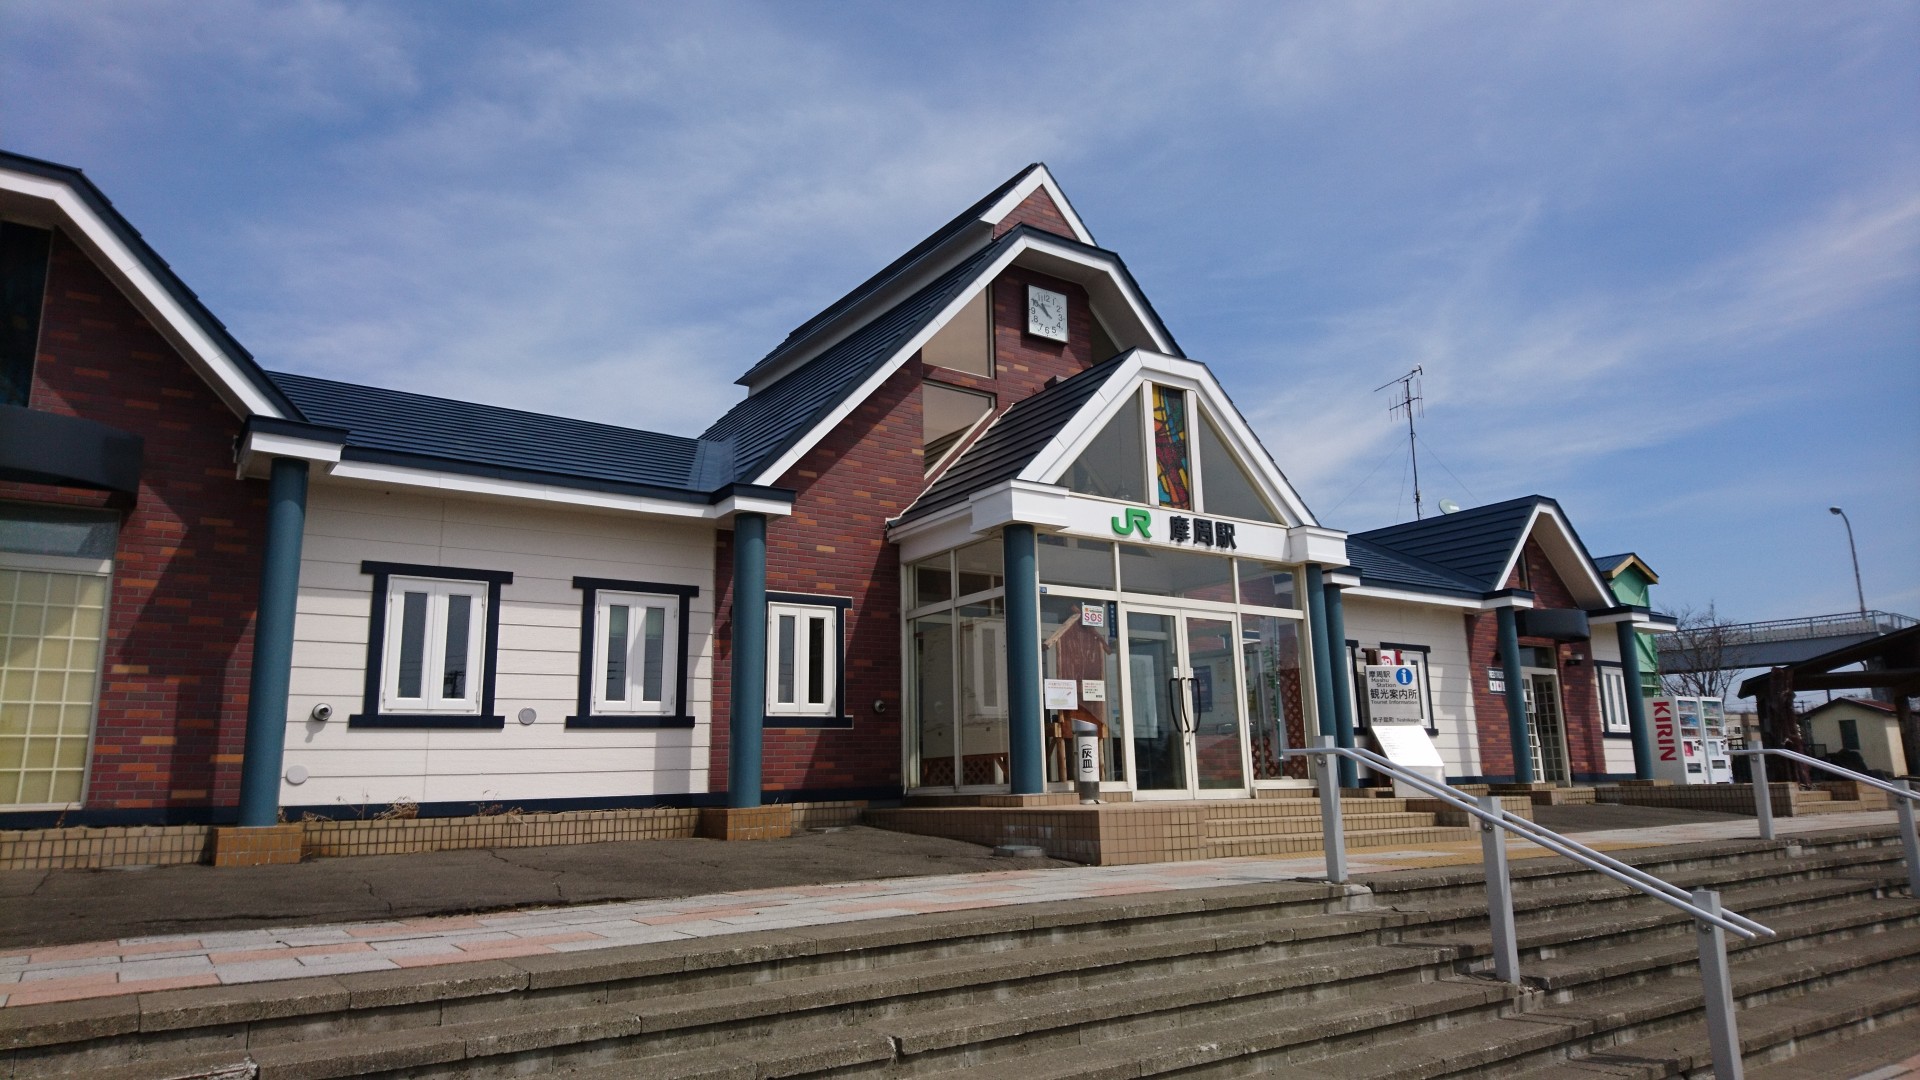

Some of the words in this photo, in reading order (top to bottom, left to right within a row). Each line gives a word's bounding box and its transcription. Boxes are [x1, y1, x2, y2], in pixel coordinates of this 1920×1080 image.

[1044, 294, 1050, 303] 12
[1033, 315, 1038, 323] 8
[1039, 322, 1043, 331] 7
[1045, 326, 1050, 334] 6
[1051, 326, 1057, 334] 5
[1111, 508, 1152, 538] JR
[1169, 516, 1237, 549] 摩周駅
[1084, 612, 1103, 622] SOS
[1370, 689, 1417, 699] 観光案内所
[1653, 701, 1677, 761] KIRIN
